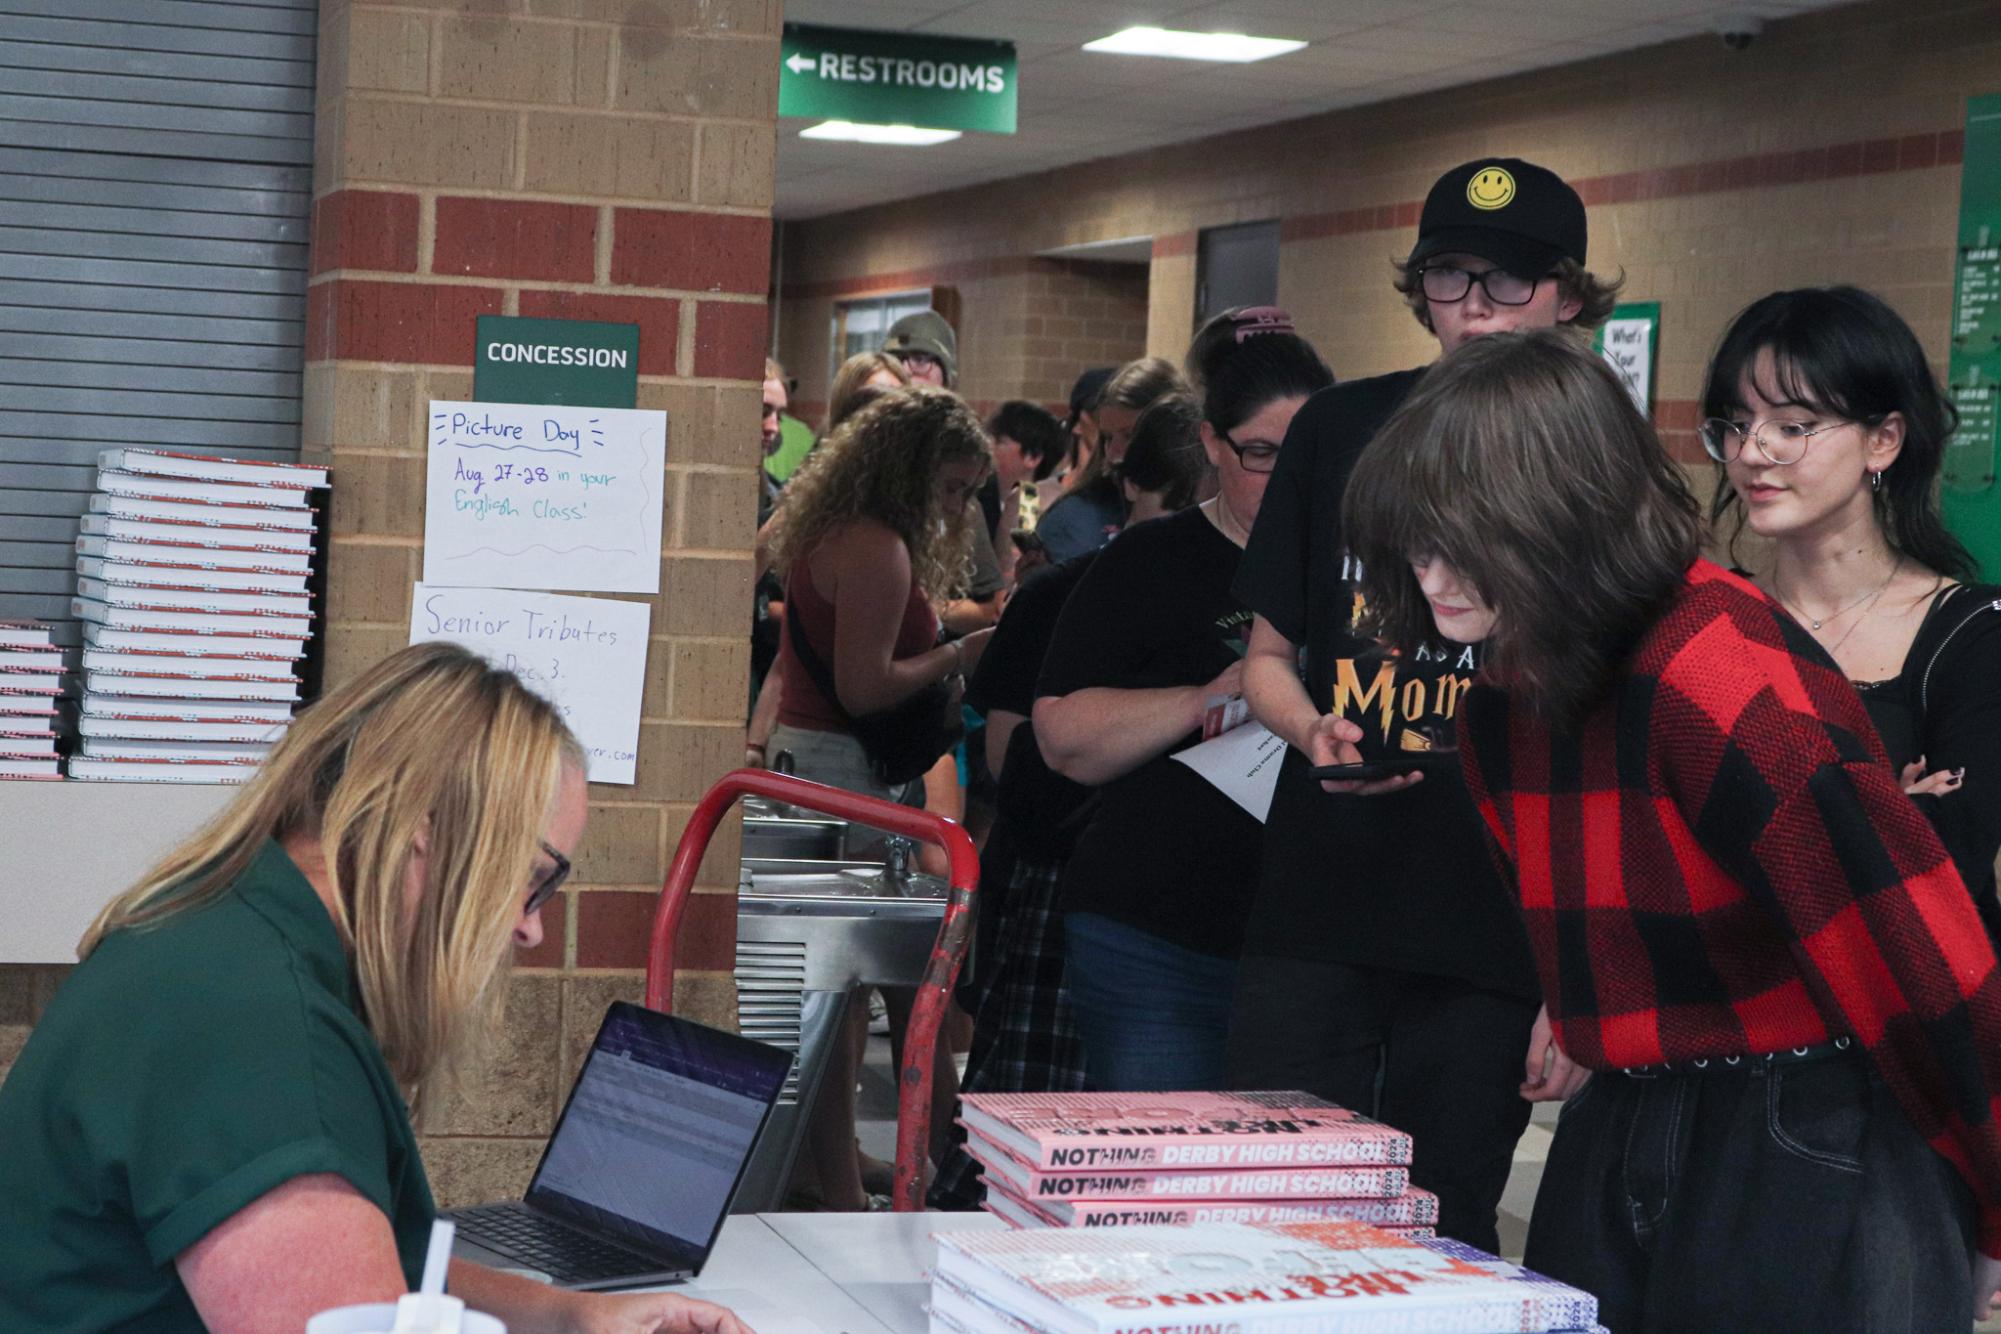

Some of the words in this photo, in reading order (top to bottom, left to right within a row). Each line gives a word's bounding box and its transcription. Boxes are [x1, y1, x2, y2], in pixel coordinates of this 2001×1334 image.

[819, 52, 1005, 93] RESTROOMS
[487, 342, 627, 369] CONCESSION
[452, 412, 523, 440] Picture
[543, 419, 580, 450] Day
[494, 464, 549, 484] 27-28
[557, 469, 570, 481] in
[580, 472, 617, 490] your
[454, 488, 520, 521] English
[425, 593, 510, 635] Senior
[522, 609, 618, 646] Tributes
[1456, 645, 1475, 670] A
[1246, 764, 1262, 778] Club
[1050, 1147, 1157, 1166] NOTHING
[1162, 1144, 1237, 1164] DERBY
[1238, 1143, 1295, 1162] HIGH
[1297, 1140, 1386, 1162] SCHOOL
[1388, 1138, 1398, 1164] 2024
[1038, 1176, 1149, 1195] NOTHING
[1152, 1175, 1228, 1194] DERBY
[1230, 1174, 1288, 1193] HIGH
[1289, 1172, 1380, 1193] SCHOOL
[1384, 1171, 1393, 1197] 2024
[1085, 1211, 1188, 1227] NOTHING
[1194, 1208, 1266, 1223] DERBY
[1268, 1206, 1323, 1222] HIGH
[1326, 1203, 1409, 1224] SCHOOL
[1413, 1199, 1423, 1225] 2024
